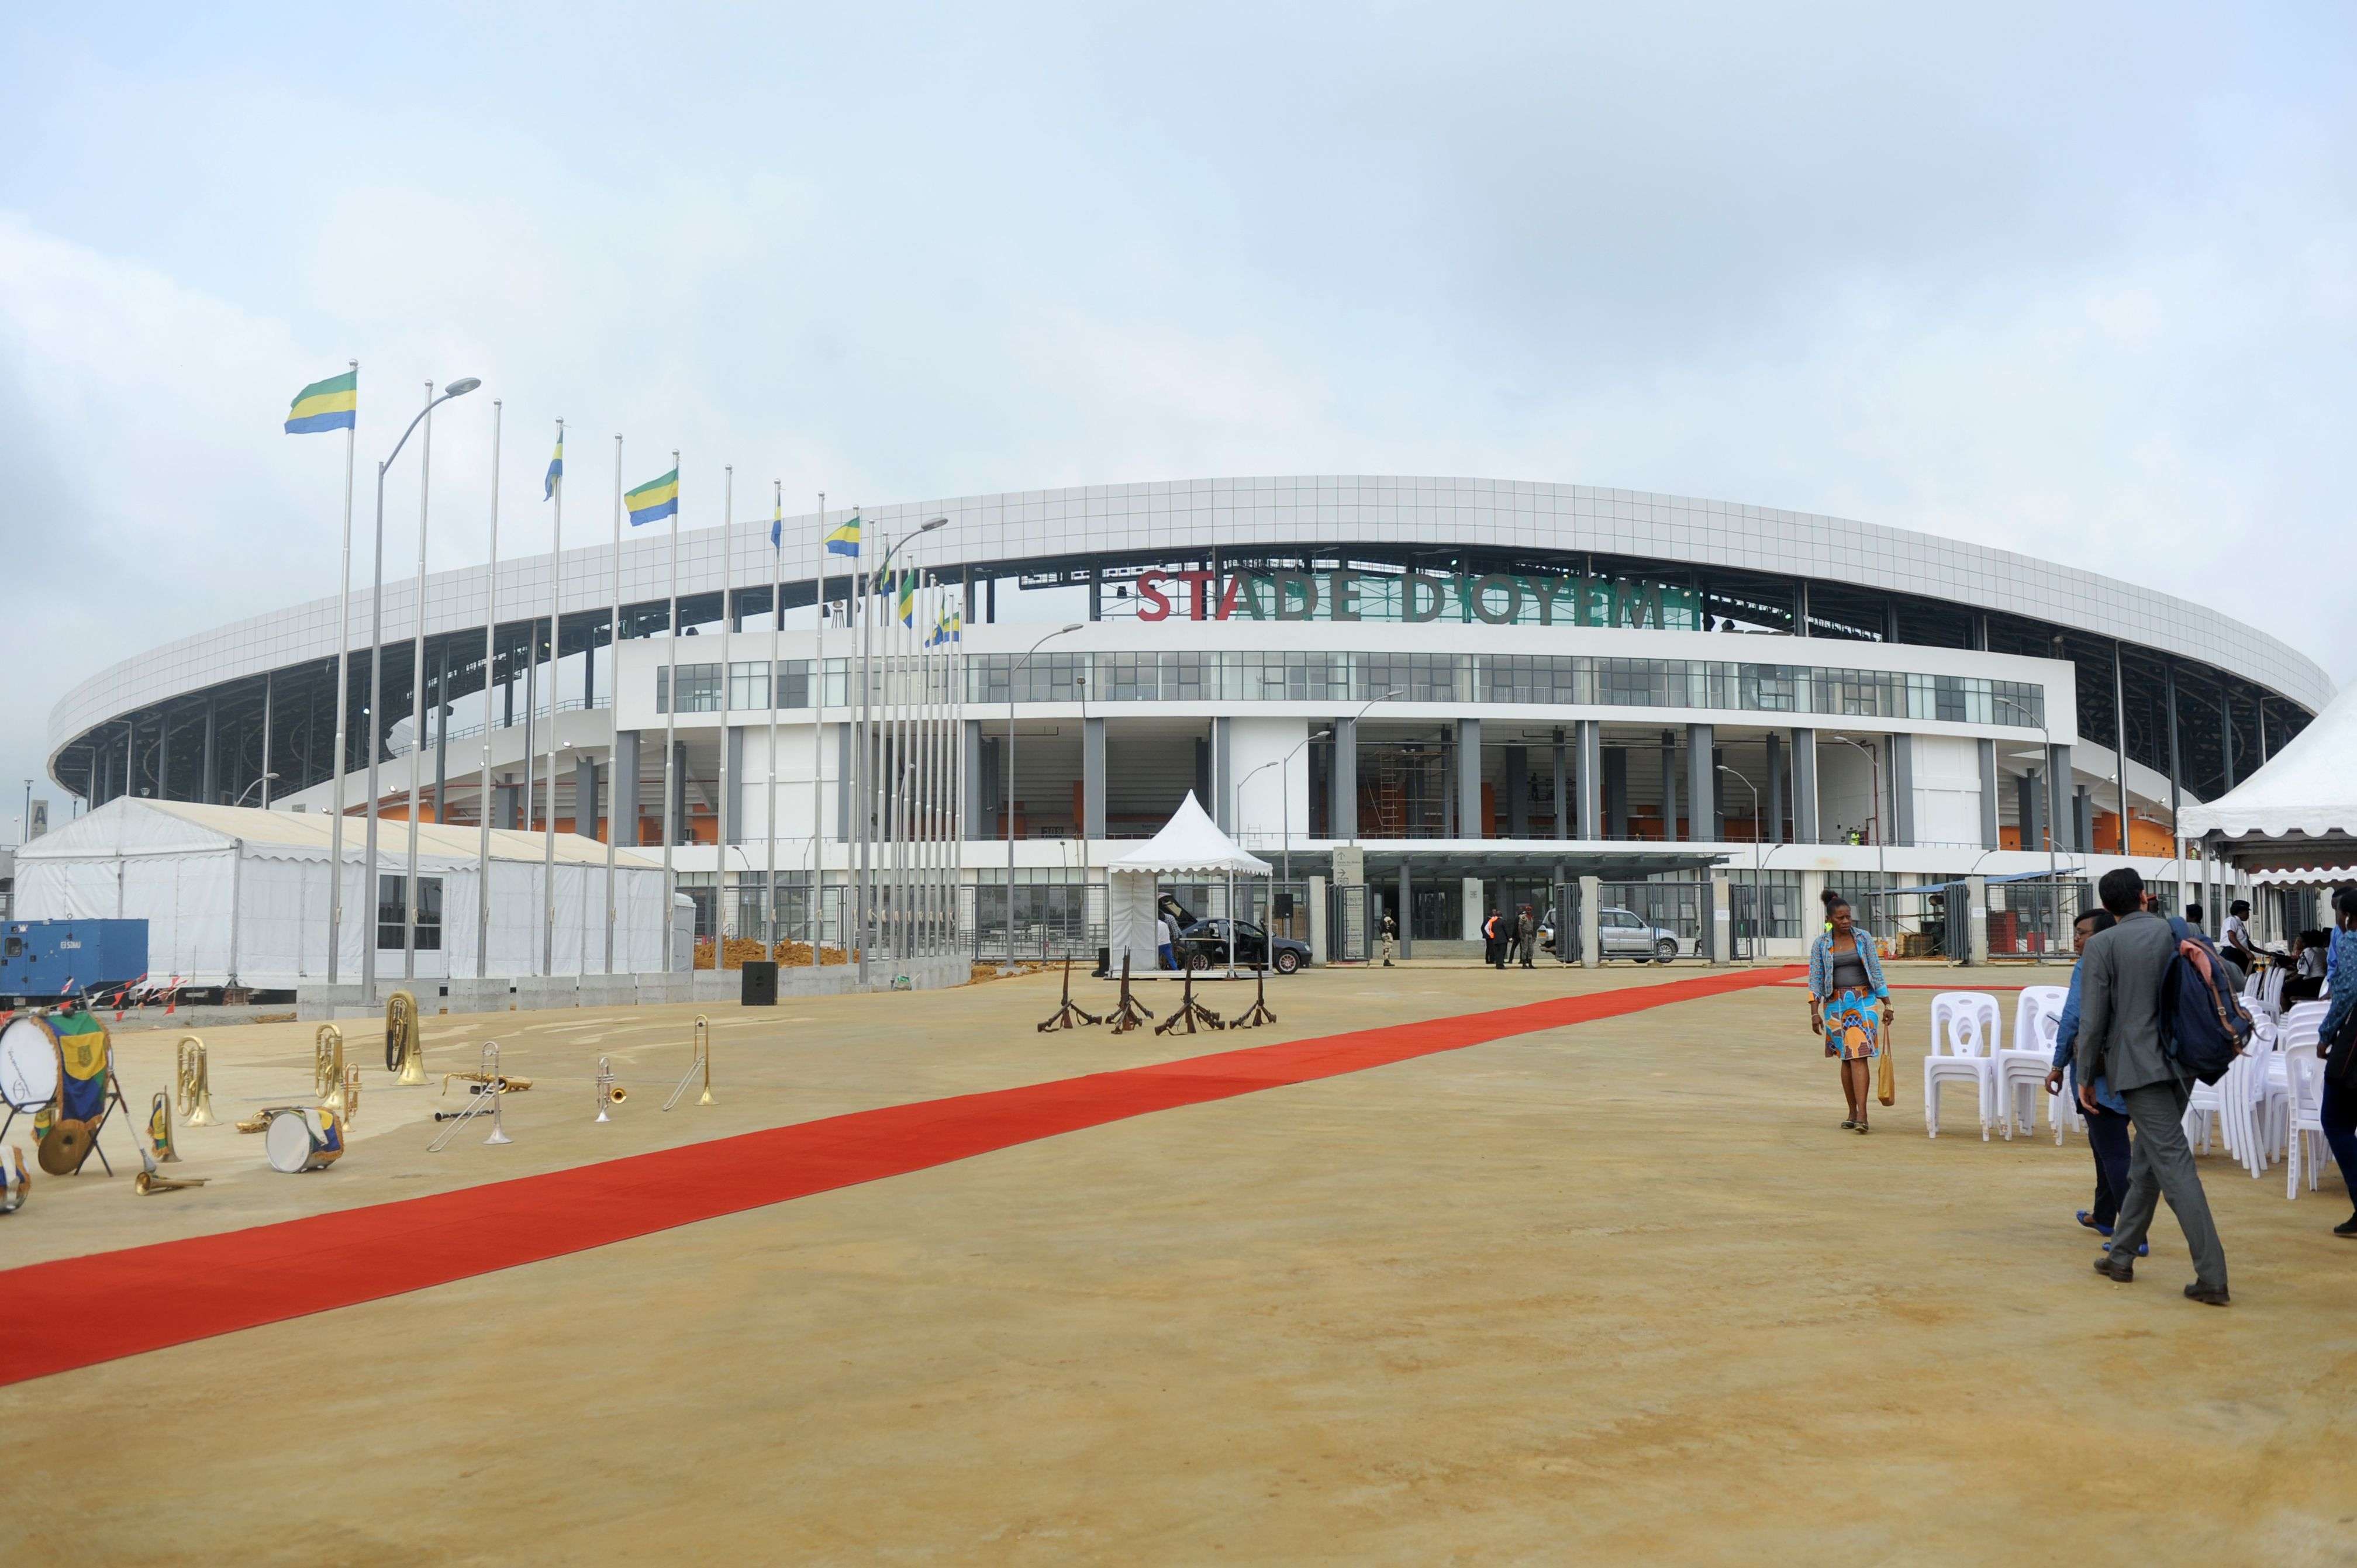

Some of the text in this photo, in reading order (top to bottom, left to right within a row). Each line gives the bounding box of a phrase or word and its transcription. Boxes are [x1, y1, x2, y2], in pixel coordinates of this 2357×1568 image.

[1137, 569, 1665, 630] STADE D'OYEM
[34, 806, 47, 824] A
